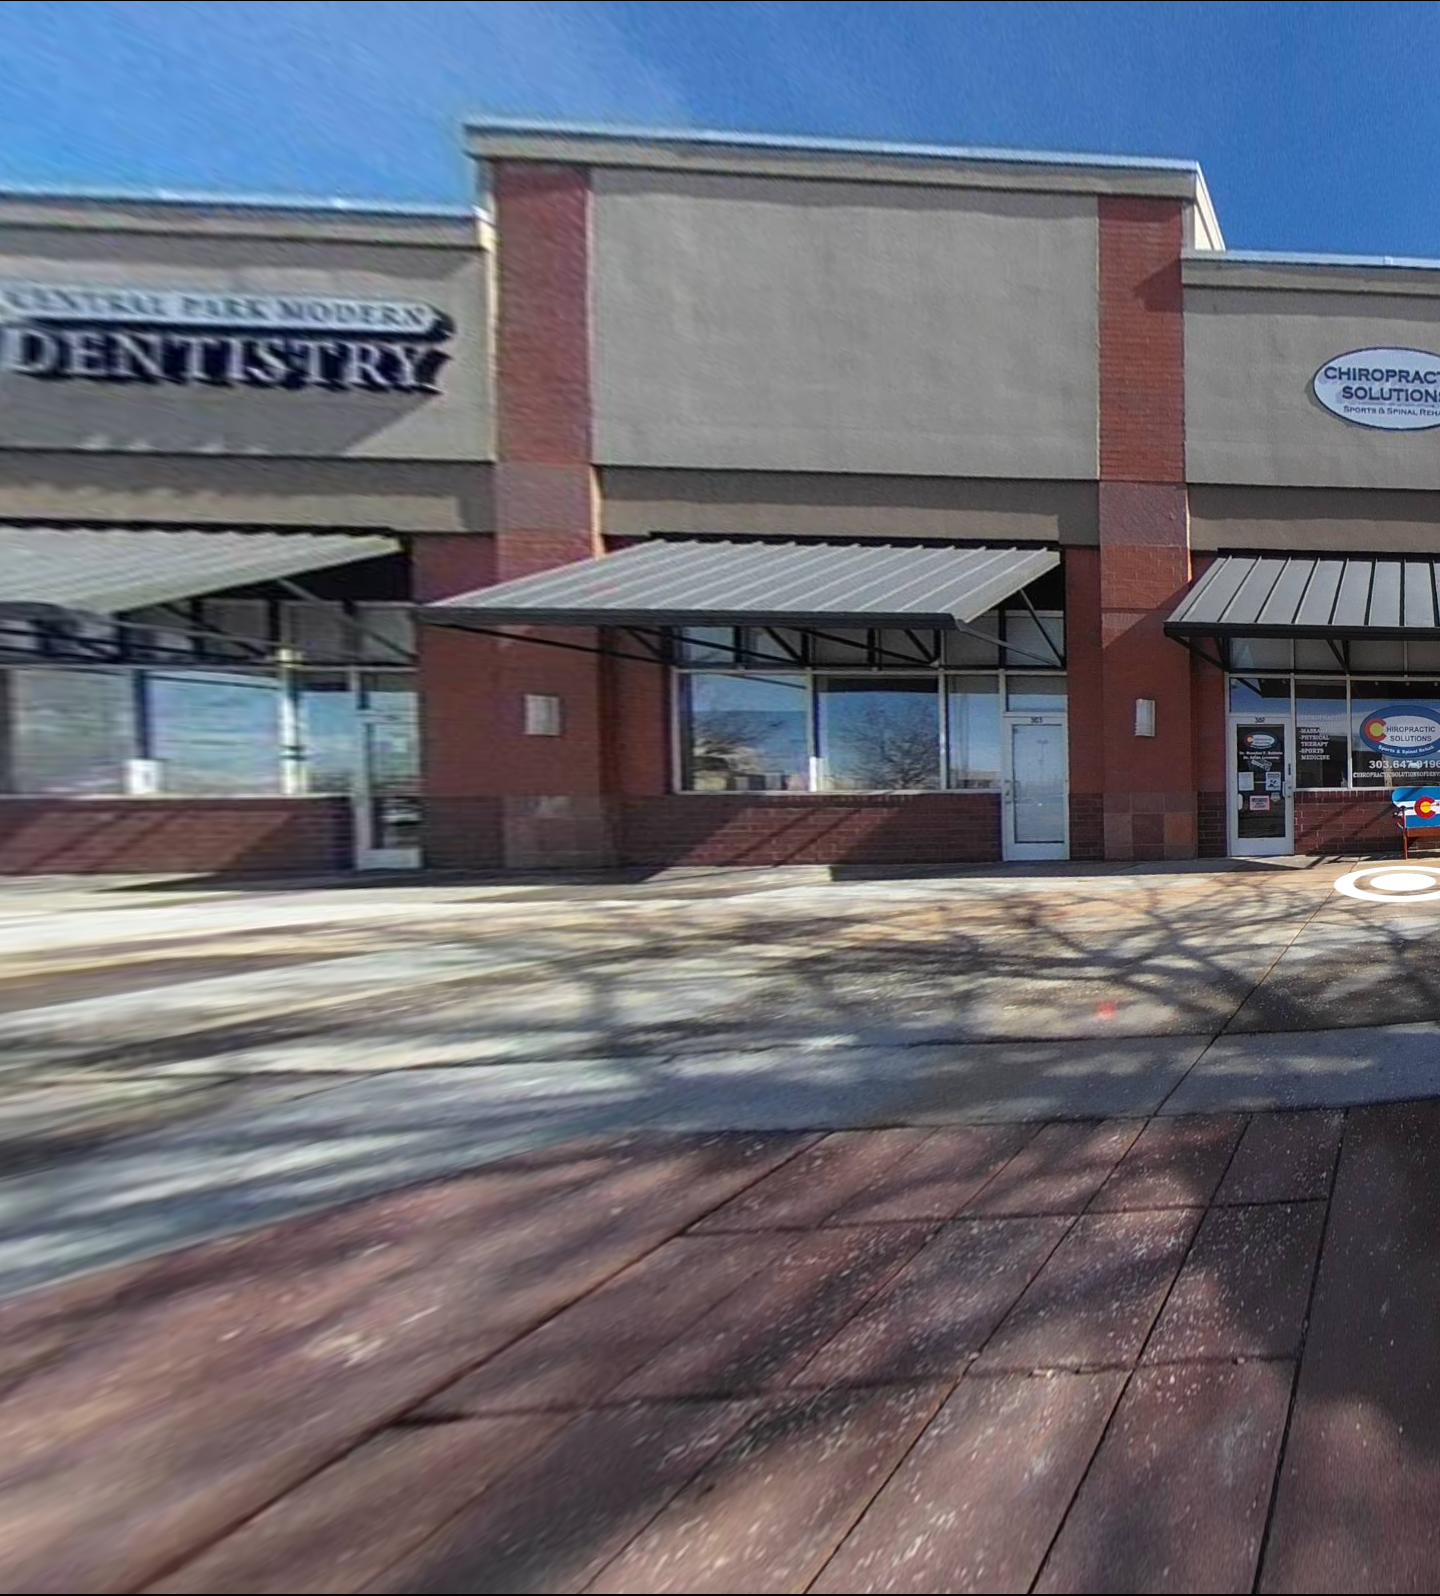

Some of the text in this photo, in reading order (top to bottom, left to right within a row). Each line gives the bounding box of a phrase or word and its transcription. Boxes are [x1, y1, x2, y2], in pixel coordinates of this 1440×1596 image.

[274, 298, 430, 329] MODERN
[3, 325, 448, 395] DENTISTRY
[1378, 744, 1395, 754] Sports
